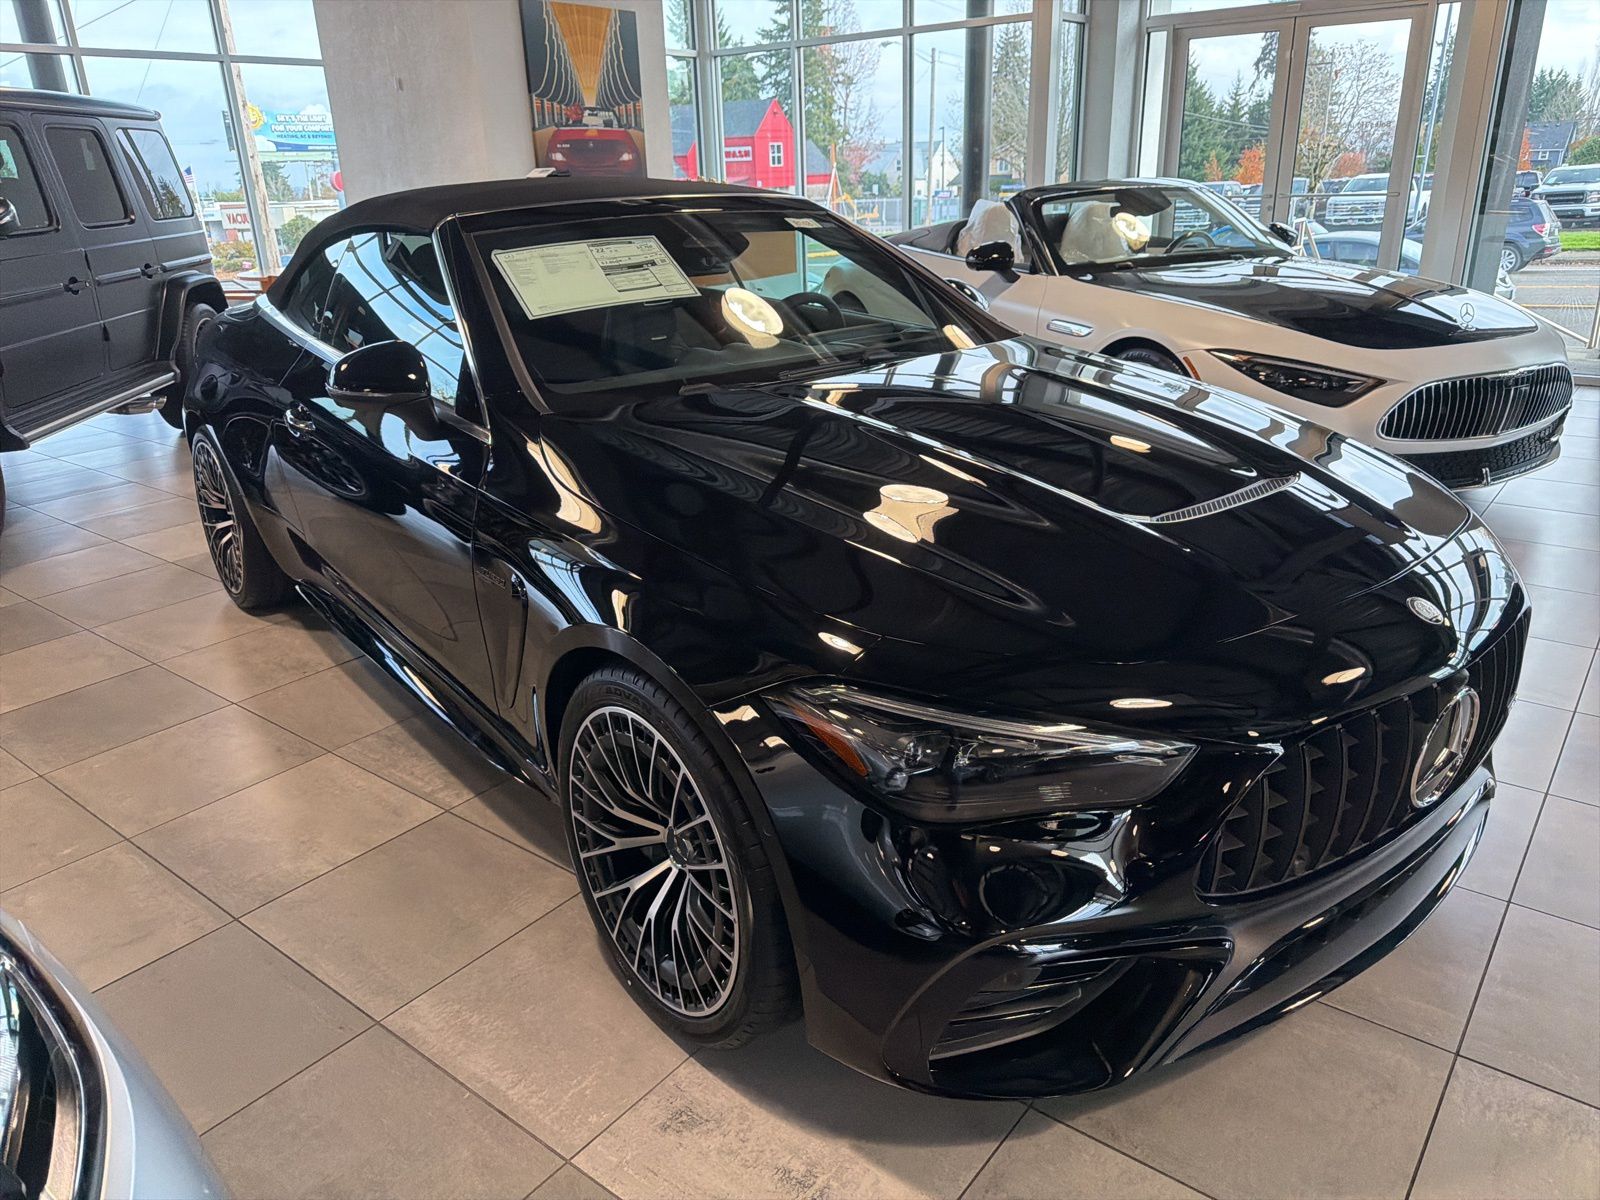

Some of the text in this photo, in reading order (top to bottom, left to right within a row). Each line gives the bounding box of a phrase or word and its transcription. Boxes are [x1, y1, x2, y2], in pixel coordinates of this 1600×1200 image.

[295, 114, 308, 122] THE
[270, 124, 284, 132] FOR
[284, 124, 303, 132] YOUR
[724, 150, 750, 158] WASH
